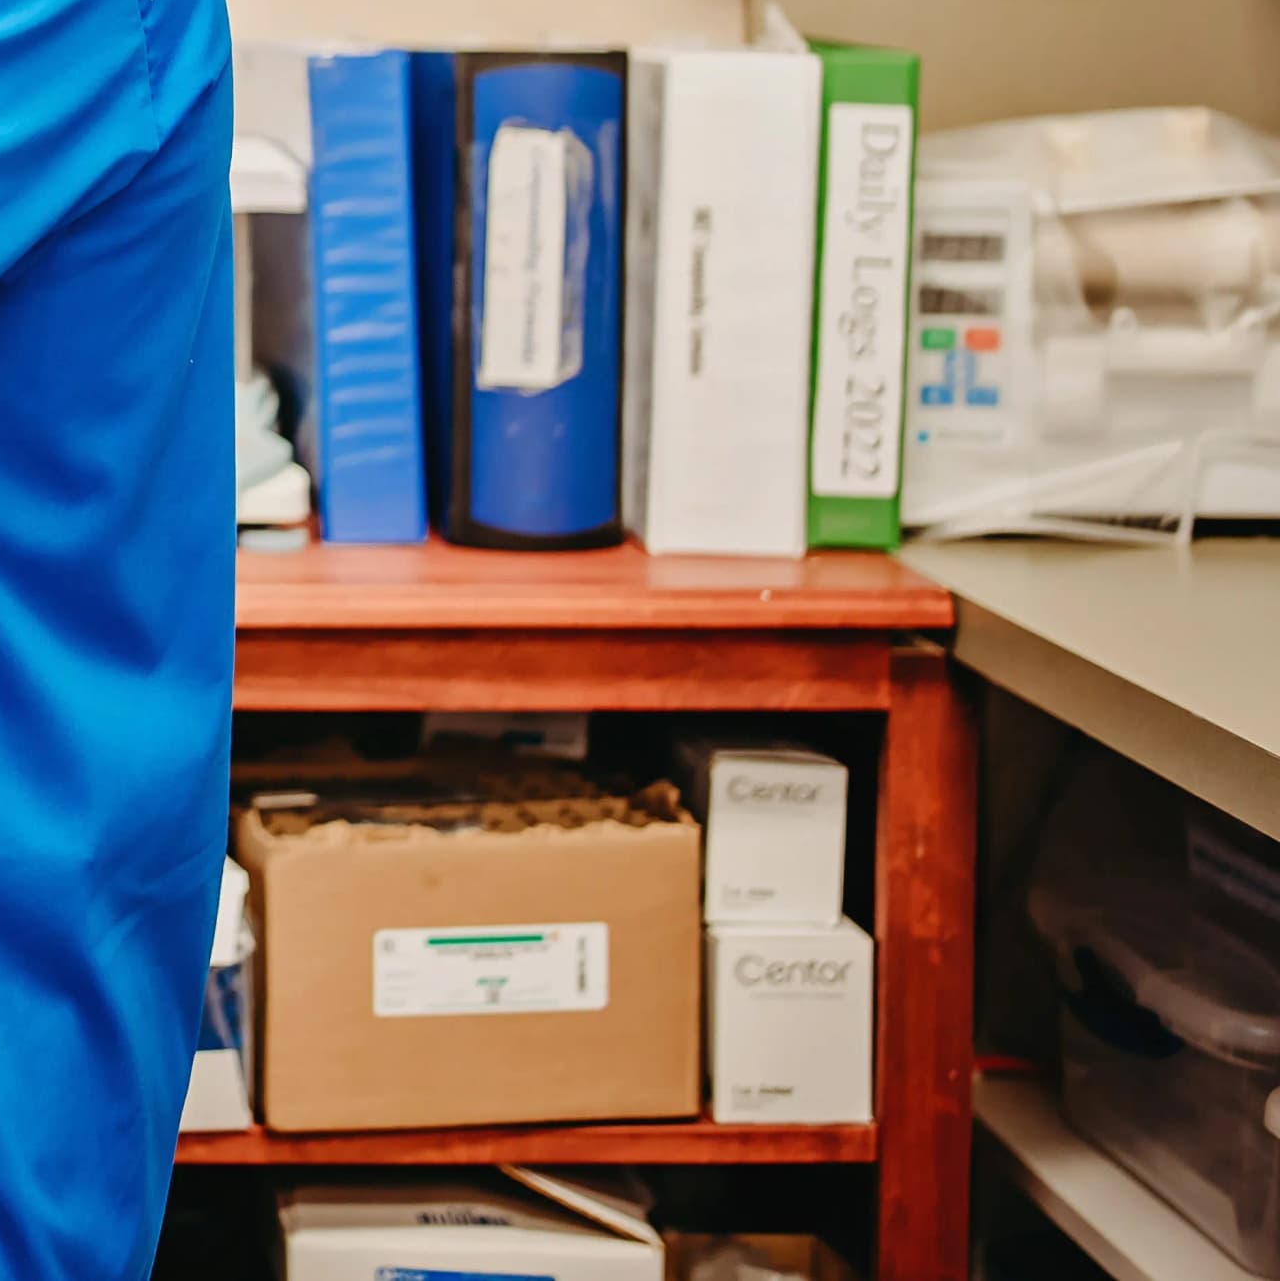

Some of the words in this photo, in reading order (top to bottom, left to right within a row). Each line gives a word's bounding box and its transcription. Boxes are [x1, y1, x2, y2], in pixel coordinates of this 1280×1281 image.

[844, 122, 900, 238] Daily
[838, 255, 893, 361] Logs
[840, 373, 887, 479] 2022
[733, 953, 853, 988] Centor
